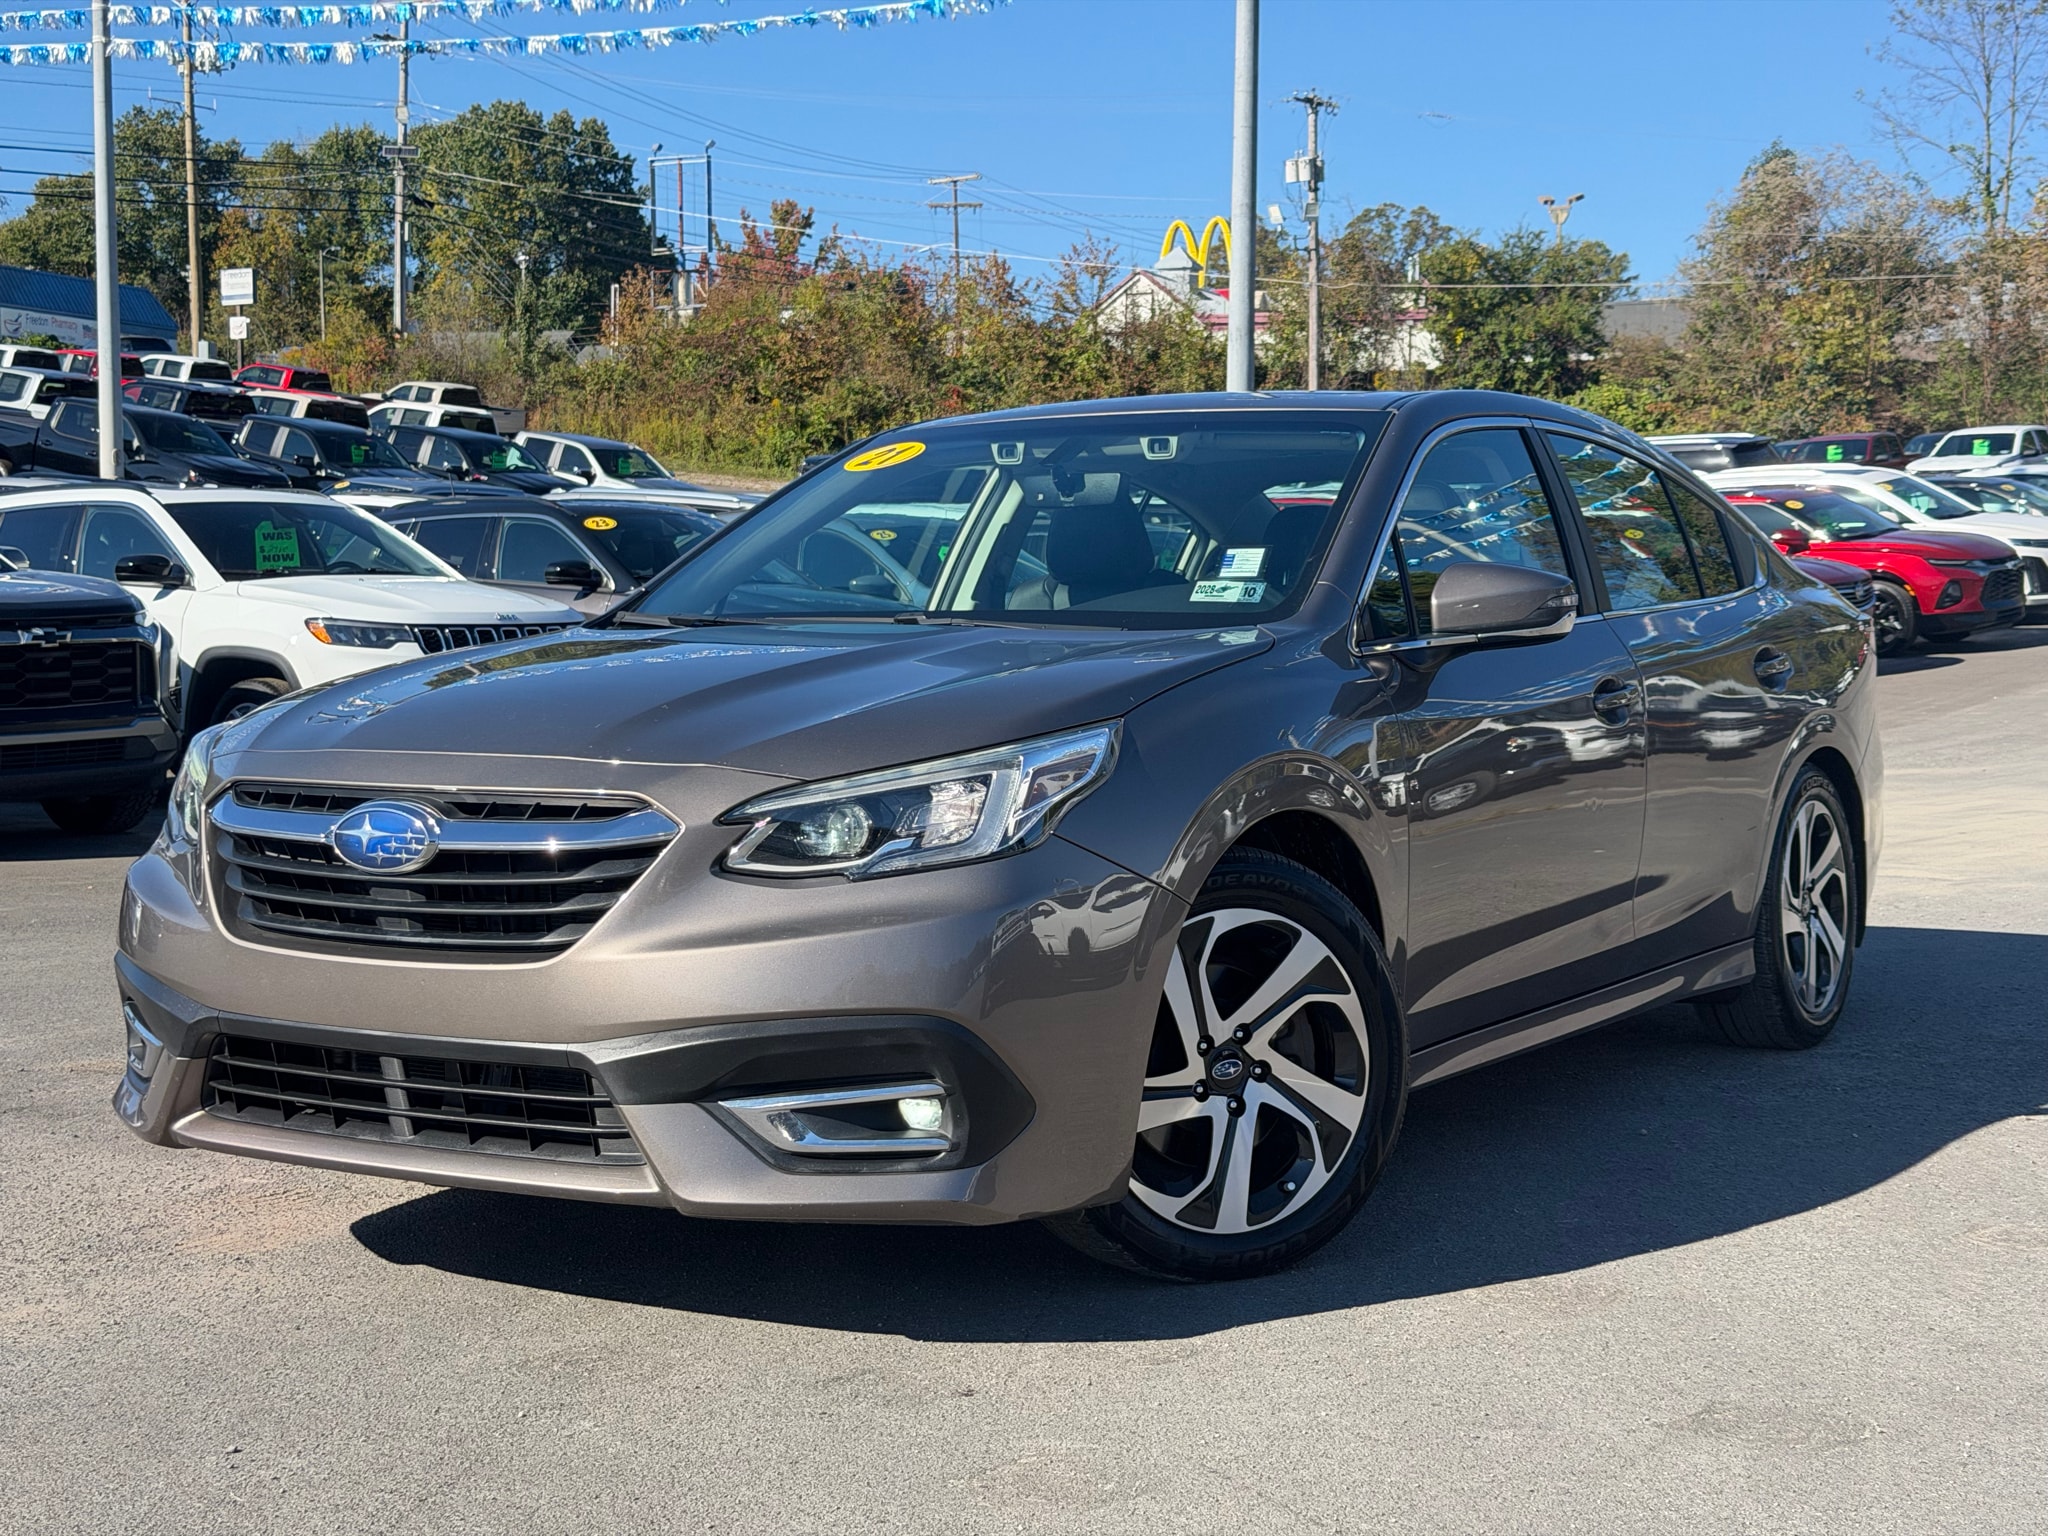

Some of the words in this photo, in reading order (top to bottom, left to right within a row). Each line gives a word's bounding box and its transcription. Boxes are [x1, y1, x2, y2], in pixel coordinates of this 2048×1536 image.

[25, 313, 49, 327] Freedom
[51, 316, 78, 333] Pharmacy
[854, 446, 915, 467] 21
[592, 519, 609, 527] 23
[262, 532, 293, 541] WAS
[262, 553, 294, 562] NOW
[1243, 587, 1256, 597] 10
